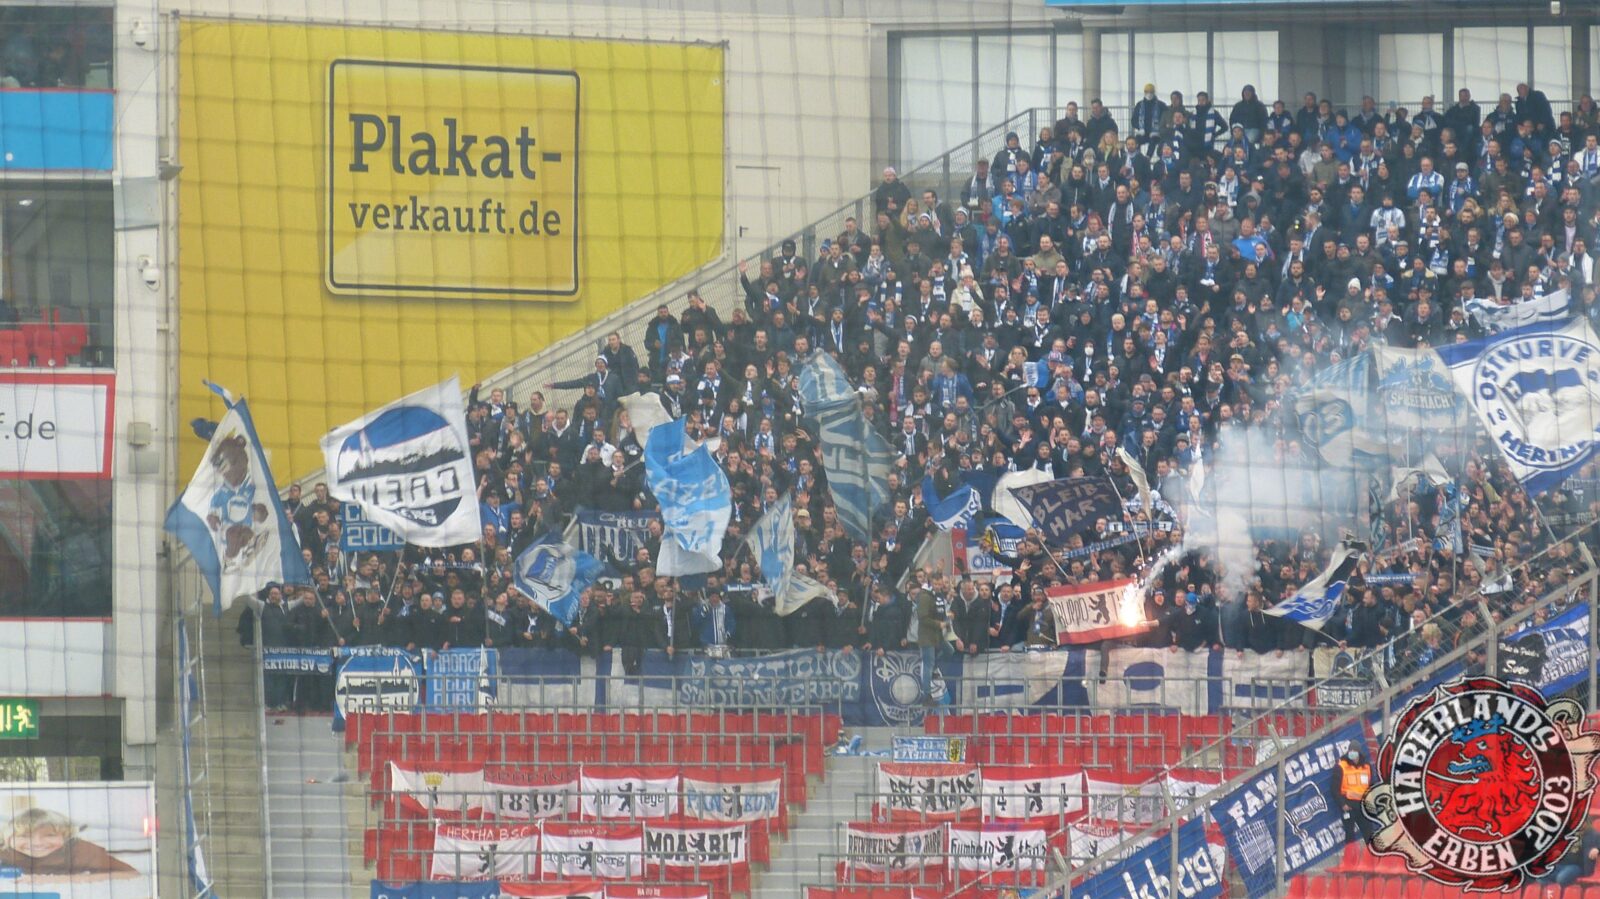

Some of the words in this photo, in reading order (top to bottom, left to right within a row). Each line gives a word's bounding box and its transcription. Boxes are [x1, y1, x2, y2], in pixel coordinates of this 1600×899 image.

[349, 113, 561, 180] Plakat-
[349, 195, 561, 236] verkauft.de
[260, 657, 299, 670] EKTION
[301, 658, 315, 671] SV
[1228, 773, 1279, 829] FAN
[446, 826, 494, 841] HERTHA
